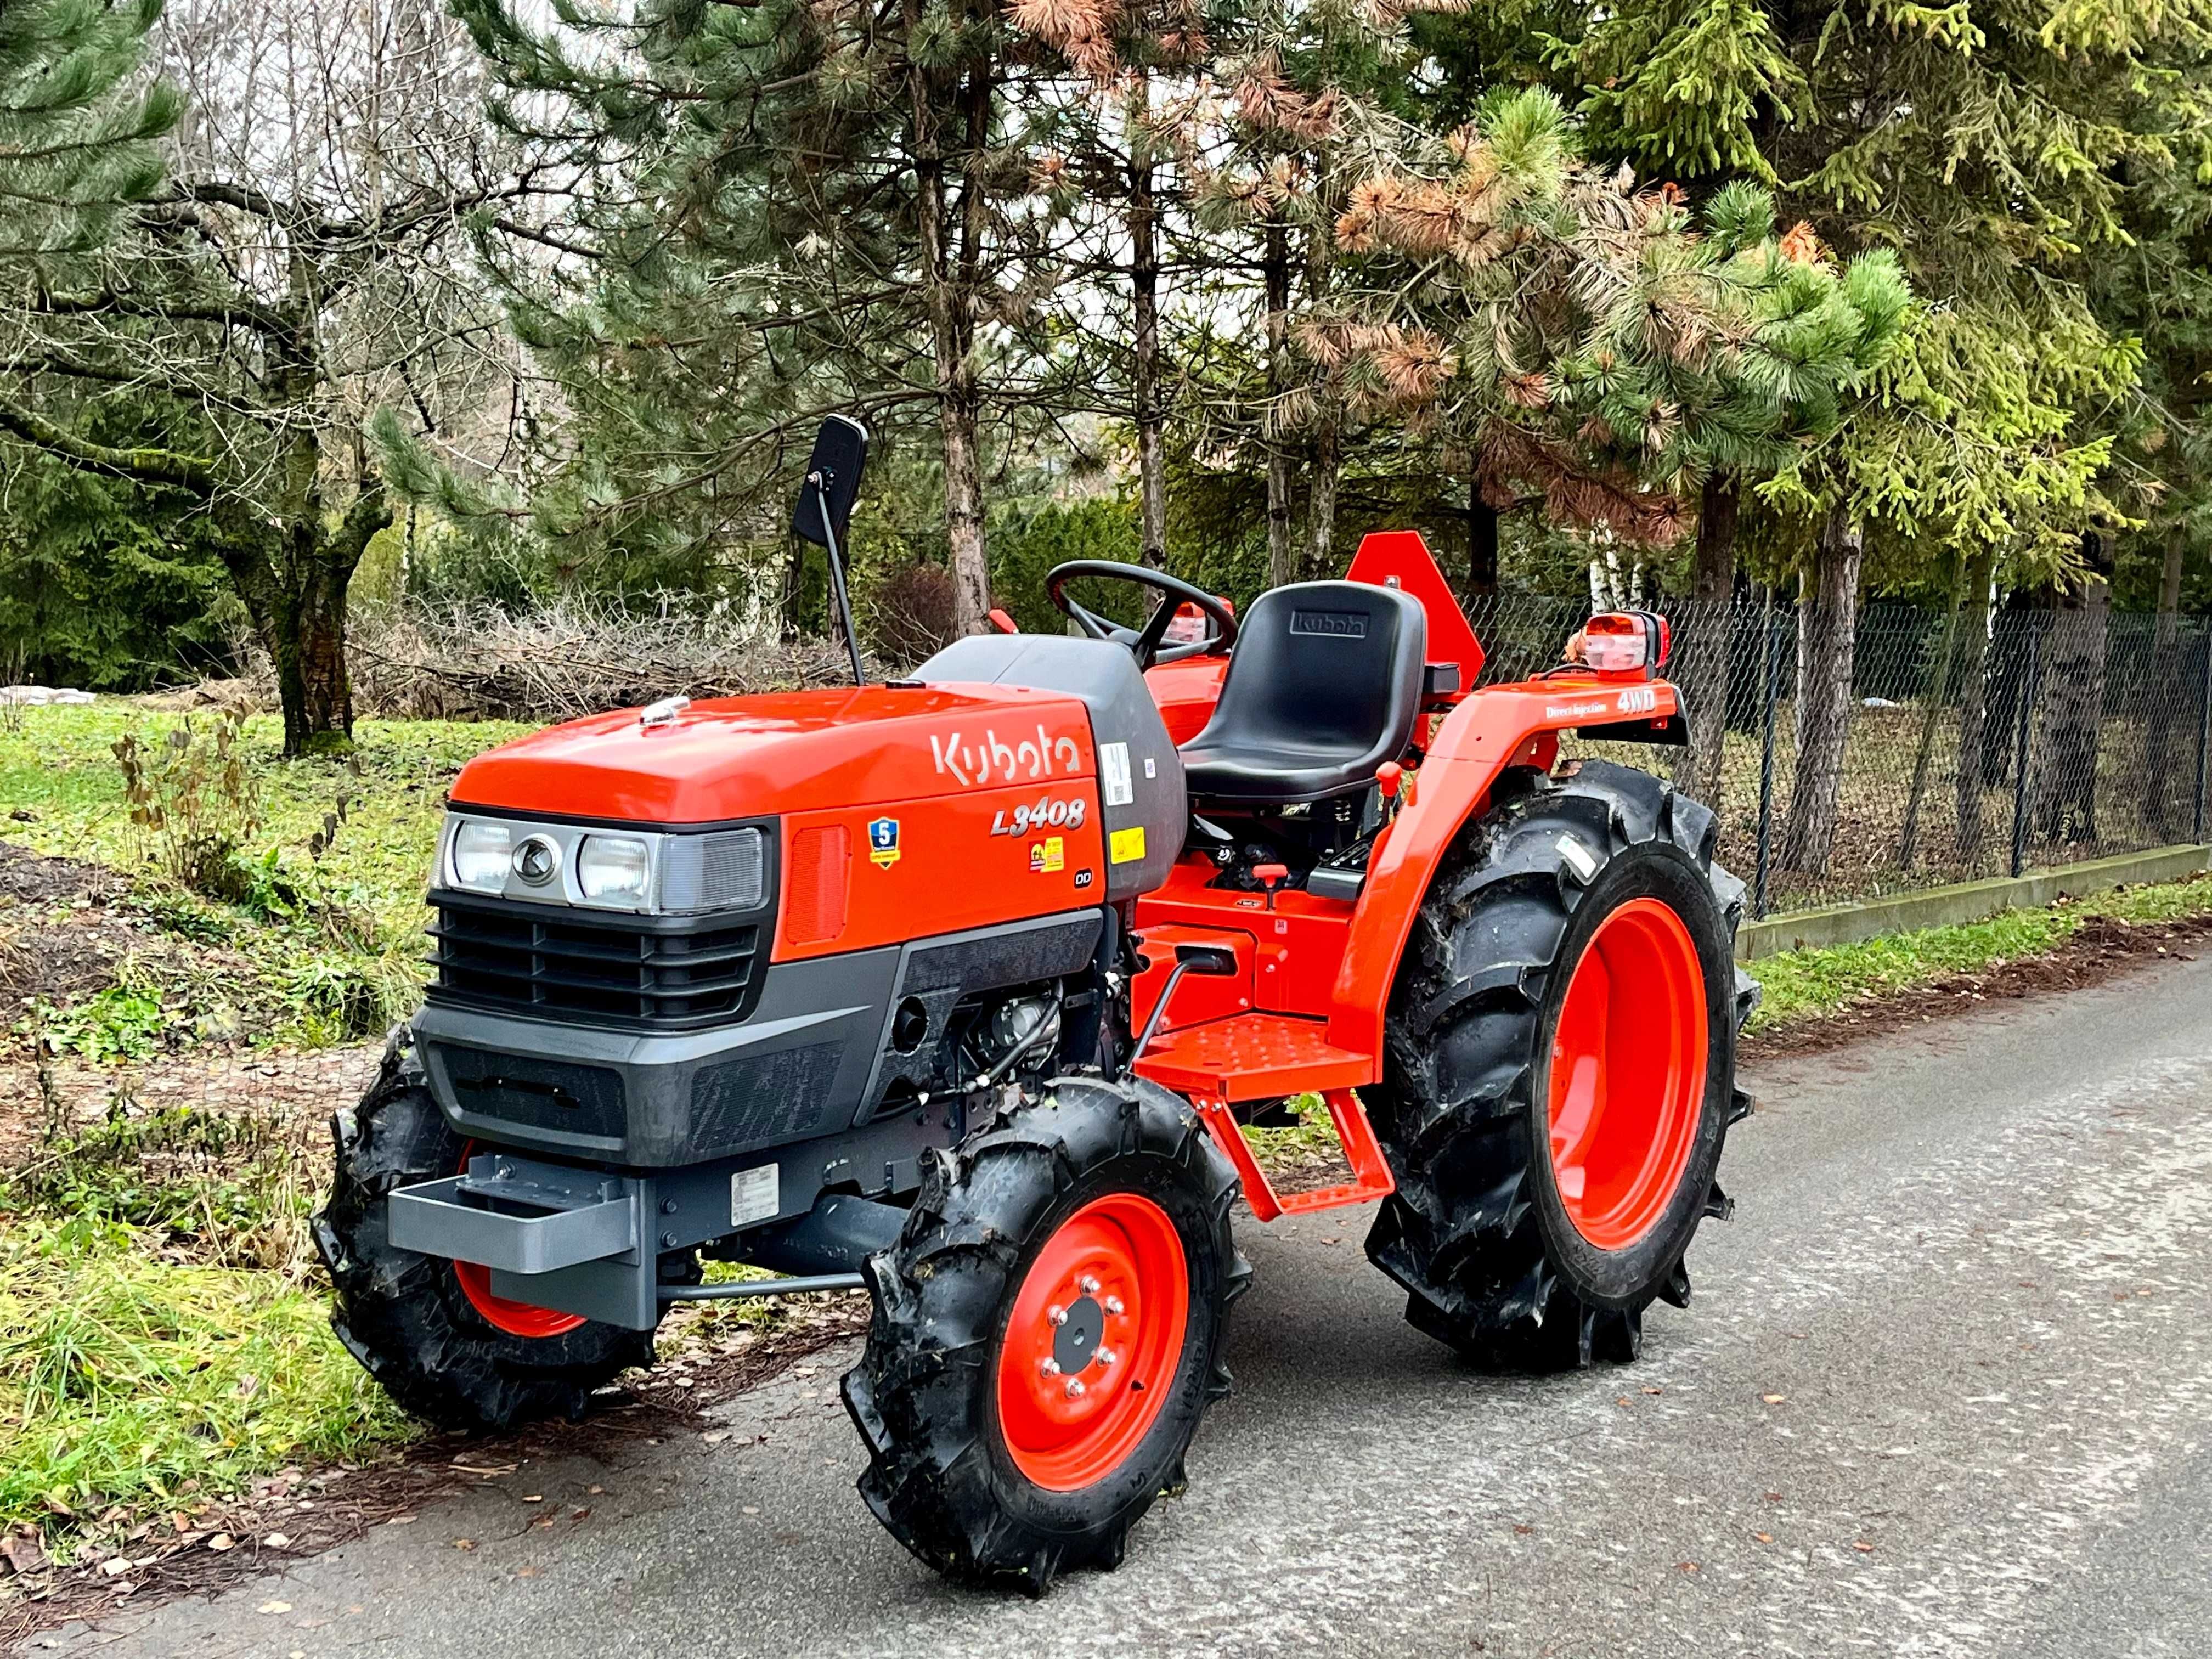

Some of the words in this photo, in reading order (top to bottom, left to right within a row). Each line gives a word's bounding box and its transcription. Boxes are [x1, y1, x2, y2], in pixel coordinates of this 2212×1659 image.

[1617, 689, 1655, 712] 4WD
[930, 724, 1080, 786] Kubota
[990, 795, 1086, 837] L3408
[878, 822, 890, 845] 5
